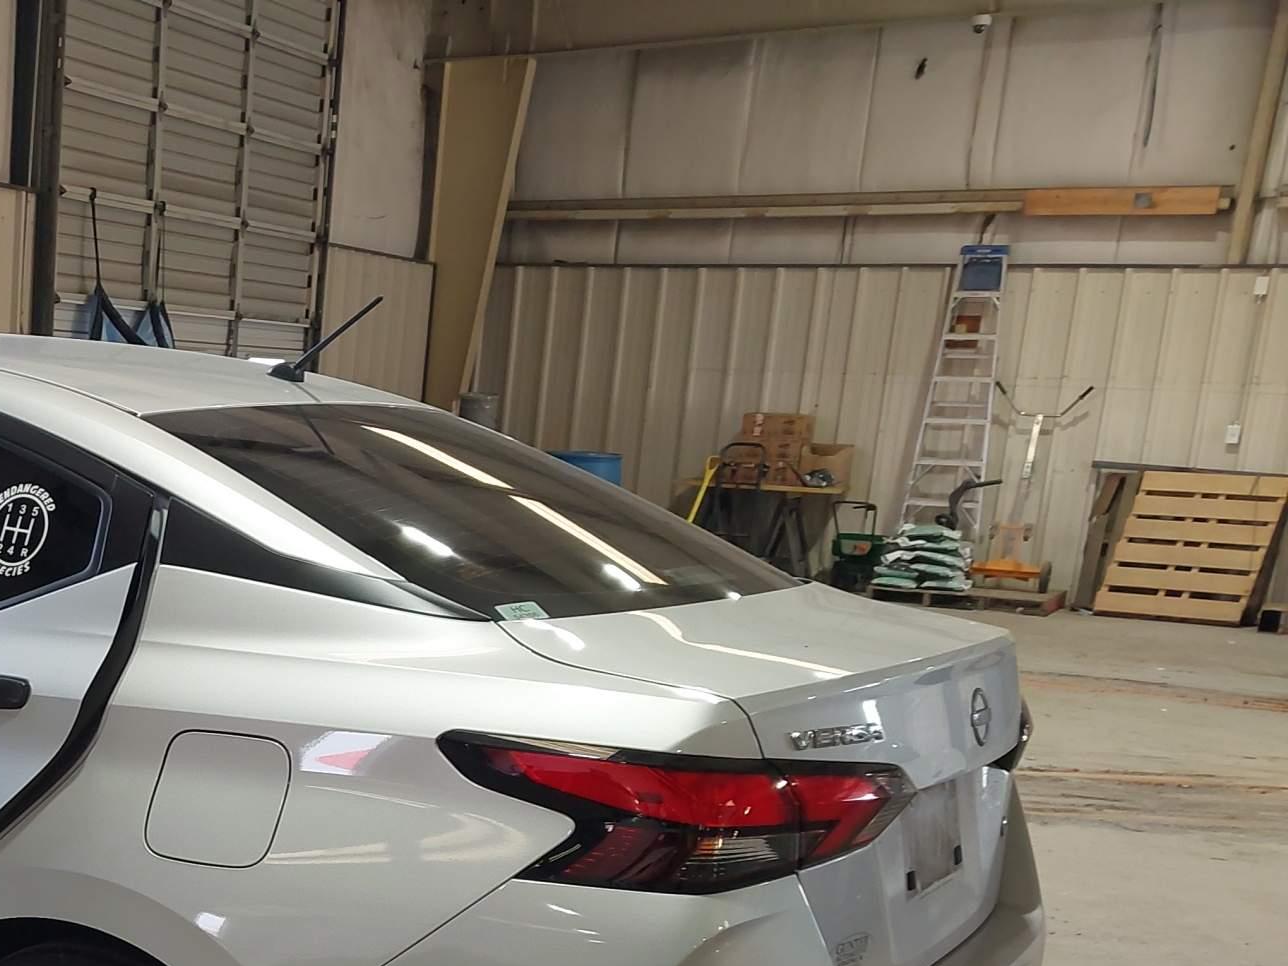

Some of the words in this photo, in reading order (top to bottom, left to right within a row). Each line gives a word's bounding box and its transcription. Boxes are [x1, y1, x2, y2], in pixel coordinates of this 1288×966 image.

[7, 503, 13, 513] 1
[19, 504, 28, 514] 3
[31, 506, 40, 517] 5
[7, 546, 14, 556] 4
[20, 548, 29, 557] R
